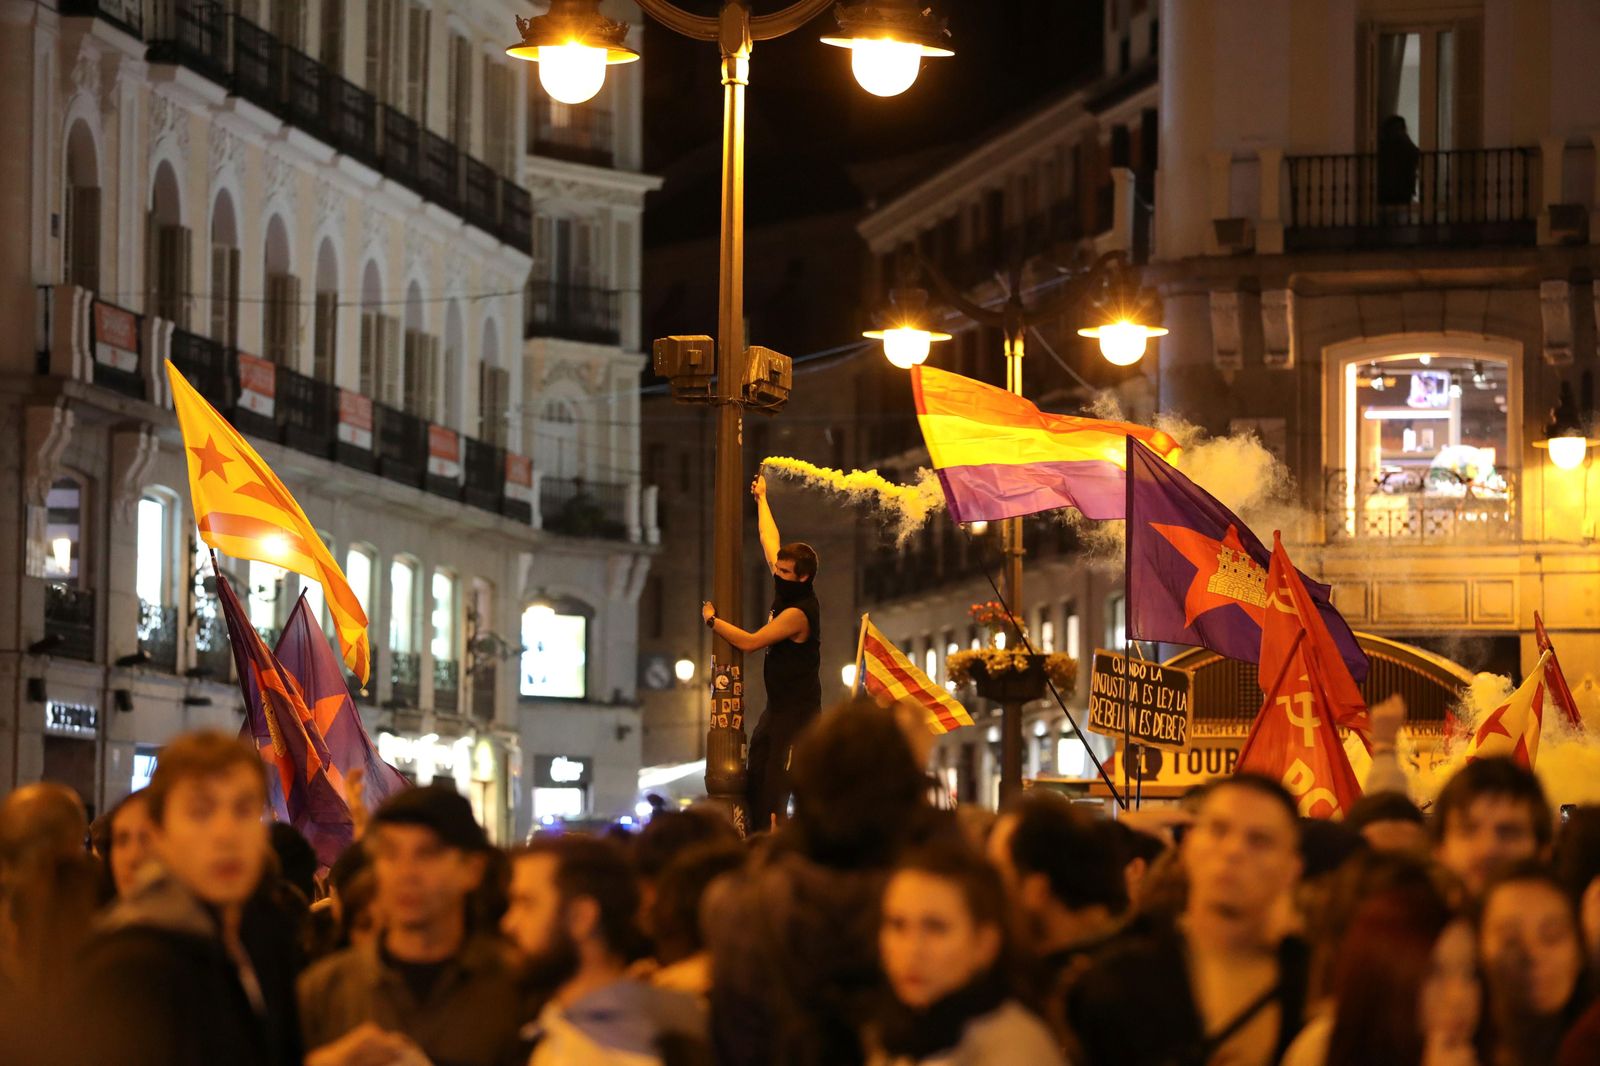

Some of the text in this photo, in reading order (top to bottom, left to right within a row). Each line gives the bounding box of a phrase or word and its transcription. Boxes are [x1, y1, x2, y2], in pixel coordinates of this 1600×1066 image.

[1113, 656, 1162, 682] CUNDO LA
[1093, 671, 1187, 712] INJUSTIIA ES LEY, LA
[1090, 695, 1186, 741] REBELIN ES DEBER
[1193, 724, 1238, 735] RANSFER
[1173, 748, 1241, 775] TOUR
